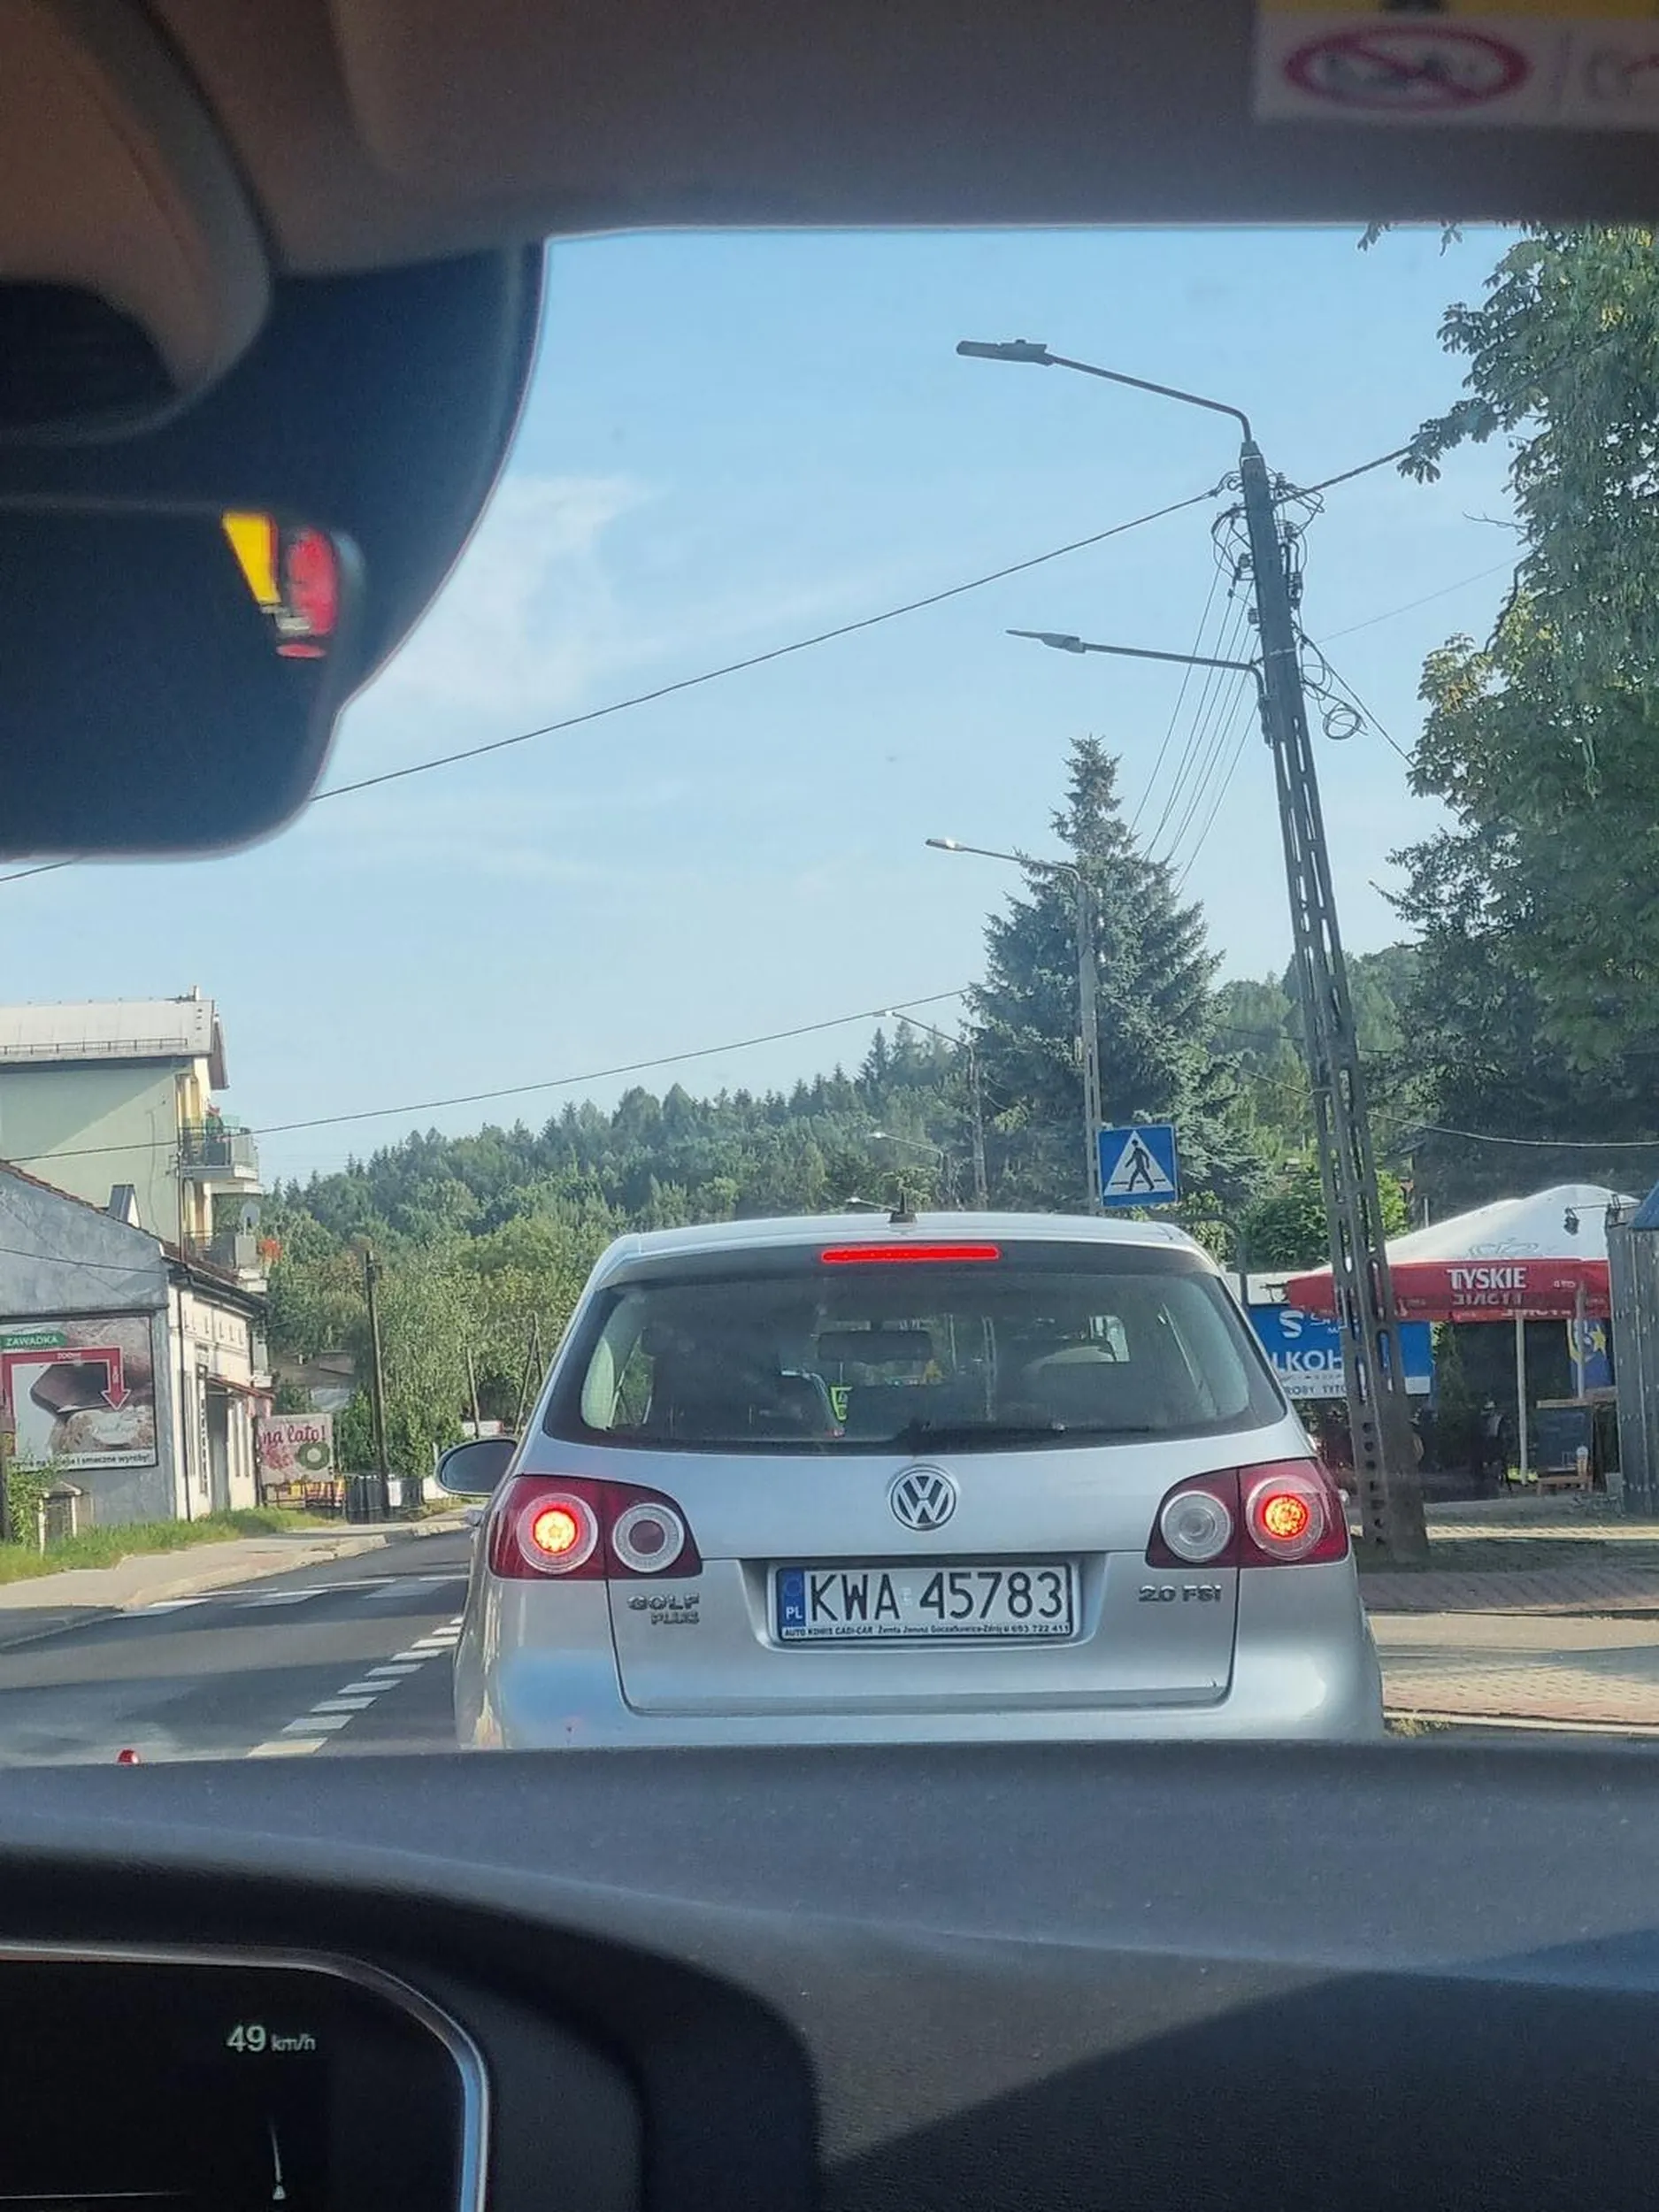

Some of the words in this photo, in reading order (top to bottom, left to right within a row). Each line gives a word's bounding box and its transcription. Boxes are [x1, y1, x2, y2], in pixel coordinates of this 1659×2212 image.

[1447, 1267, 1527, 1290] TYSKIE
[6, 1336, 59, 1347] ZAWADKA
[287, 1425, 326, 1443] lato!
[626, 1593, 700, 1610] GOLF
[810, 1574, 901, 1621] KWA
[919, 1571, 1063, 1620] 45783
[786, 1607, 803, 1620] PL
[226, 2024, 266, 2053] 49
[271, 2033, 316, 2052] km/h
